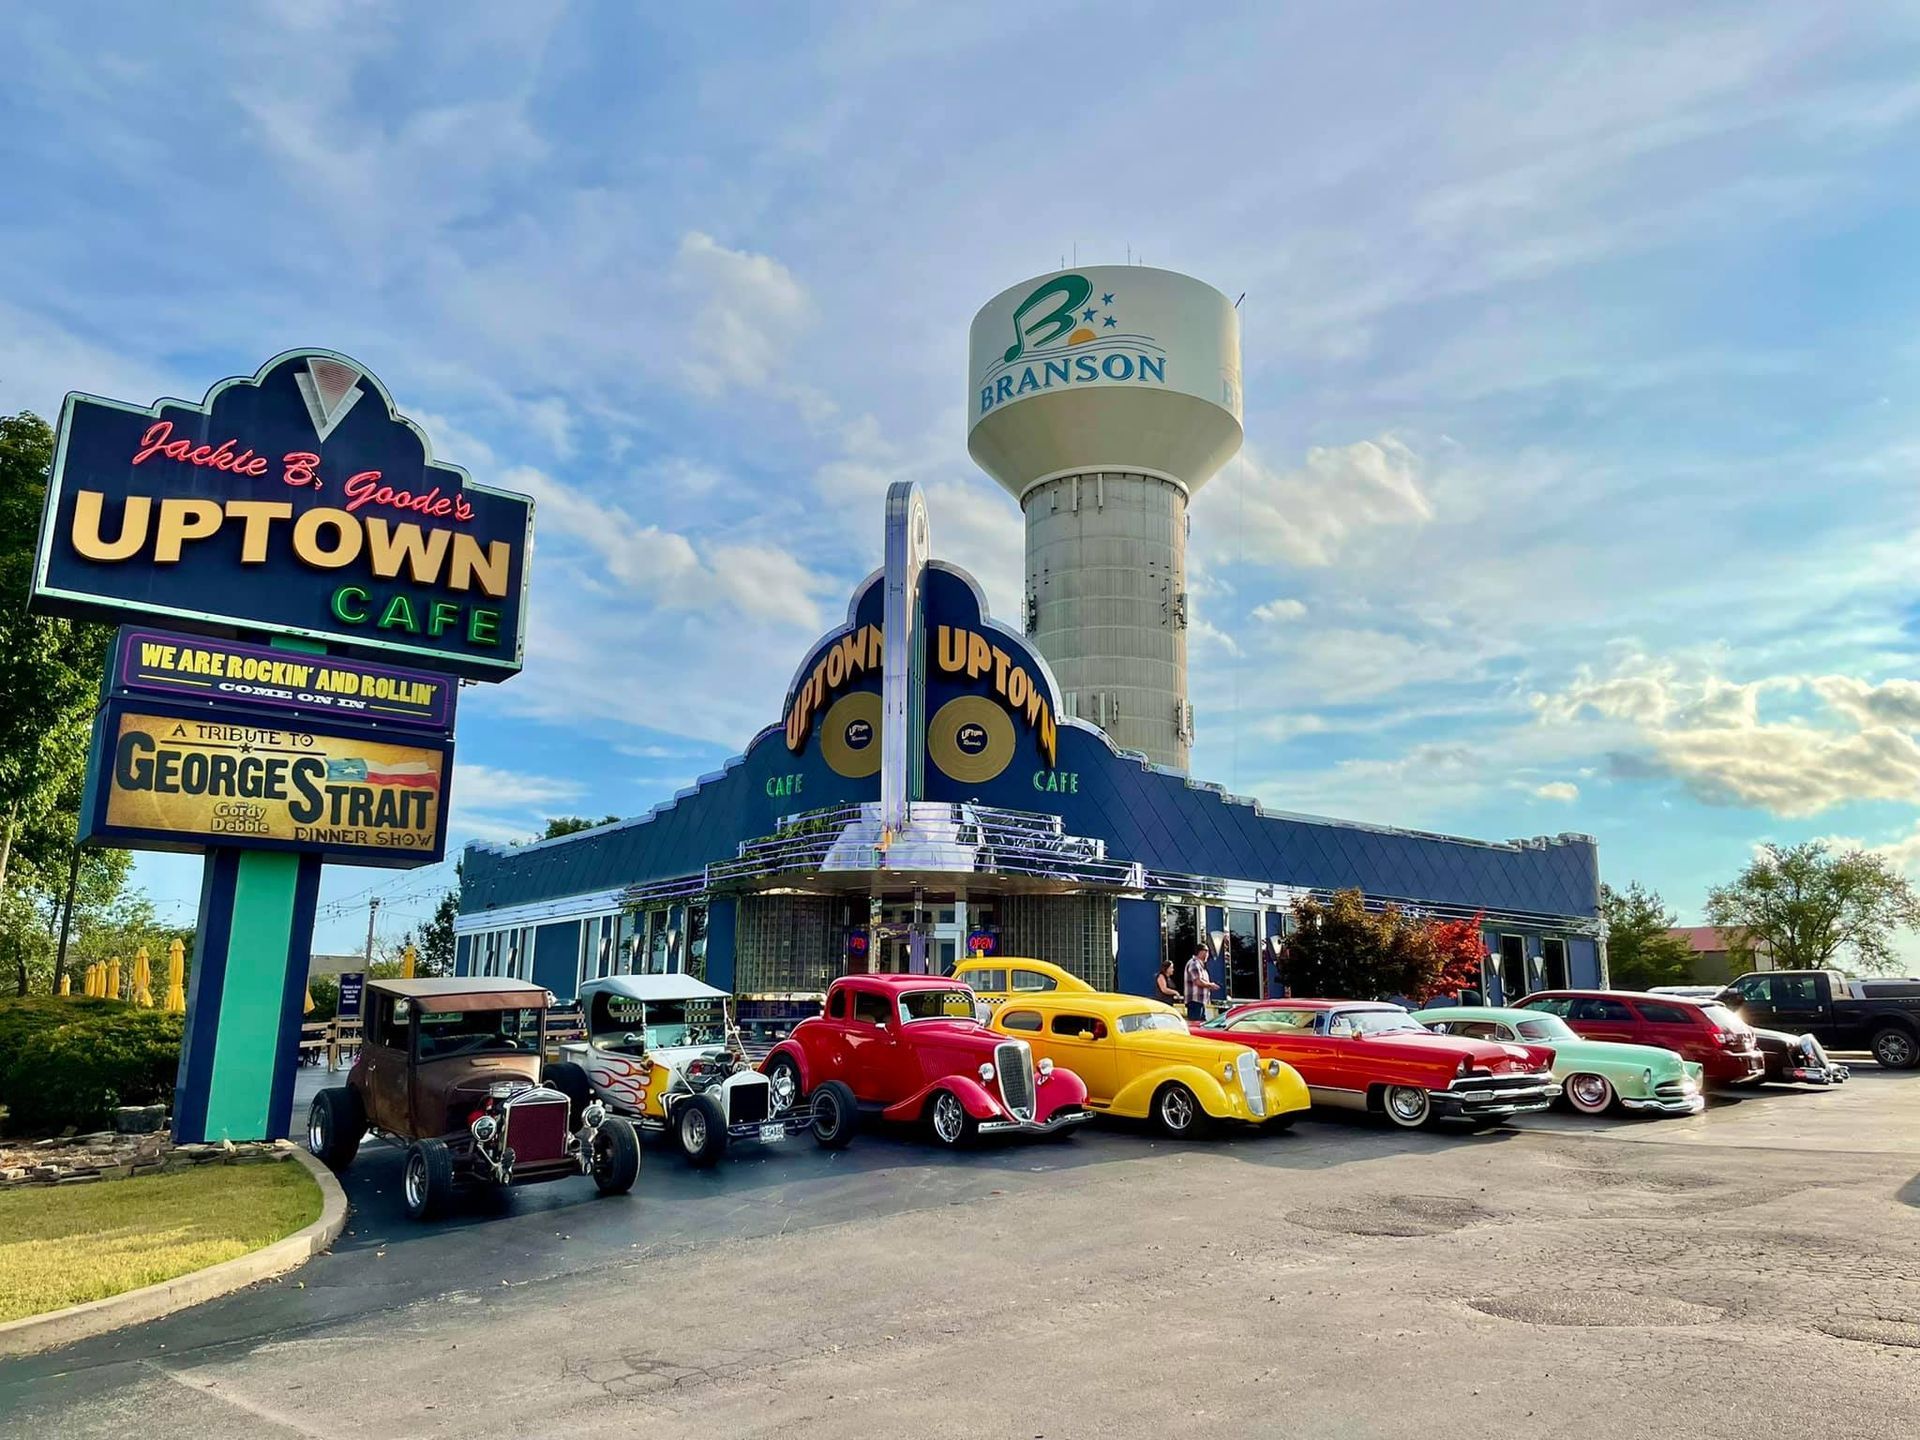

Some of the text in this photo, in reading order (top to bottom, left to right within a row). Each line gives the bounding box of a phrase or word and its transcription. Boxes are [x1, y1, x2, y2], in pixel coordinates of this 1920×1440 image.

[980, 354, 1167, 415] BRANSON
[131, 421, 268, 476] Jackie
[344, 471, 475, 522] Goode's
[71, 489, 511, 598] UPTOWN
[331, 585, 501, 645] CAFE
[141, 642, 437, 706] WE ARE ROCKIN' AND ROLLIN'
[219, 682, 367, 710] COME ON IN
[786, 623, 883, 750] UPTOWN
[938, 625, 1057, 768] UPTOWN
[172, 723, 314, 747] A TRIBUTE TO
[116, 731, 434, 829] GEORGE STRAIT
[766, 773, 803, 798] CAFE
[1033, 770, 1079, 793] CAFE
[211, 817, 269, 833] Debbie
[214, 802, 267, 821] Gordy
[293, 826, 433, 848] DINNER SHOW
[969, 936, 994, 950] OPEN
